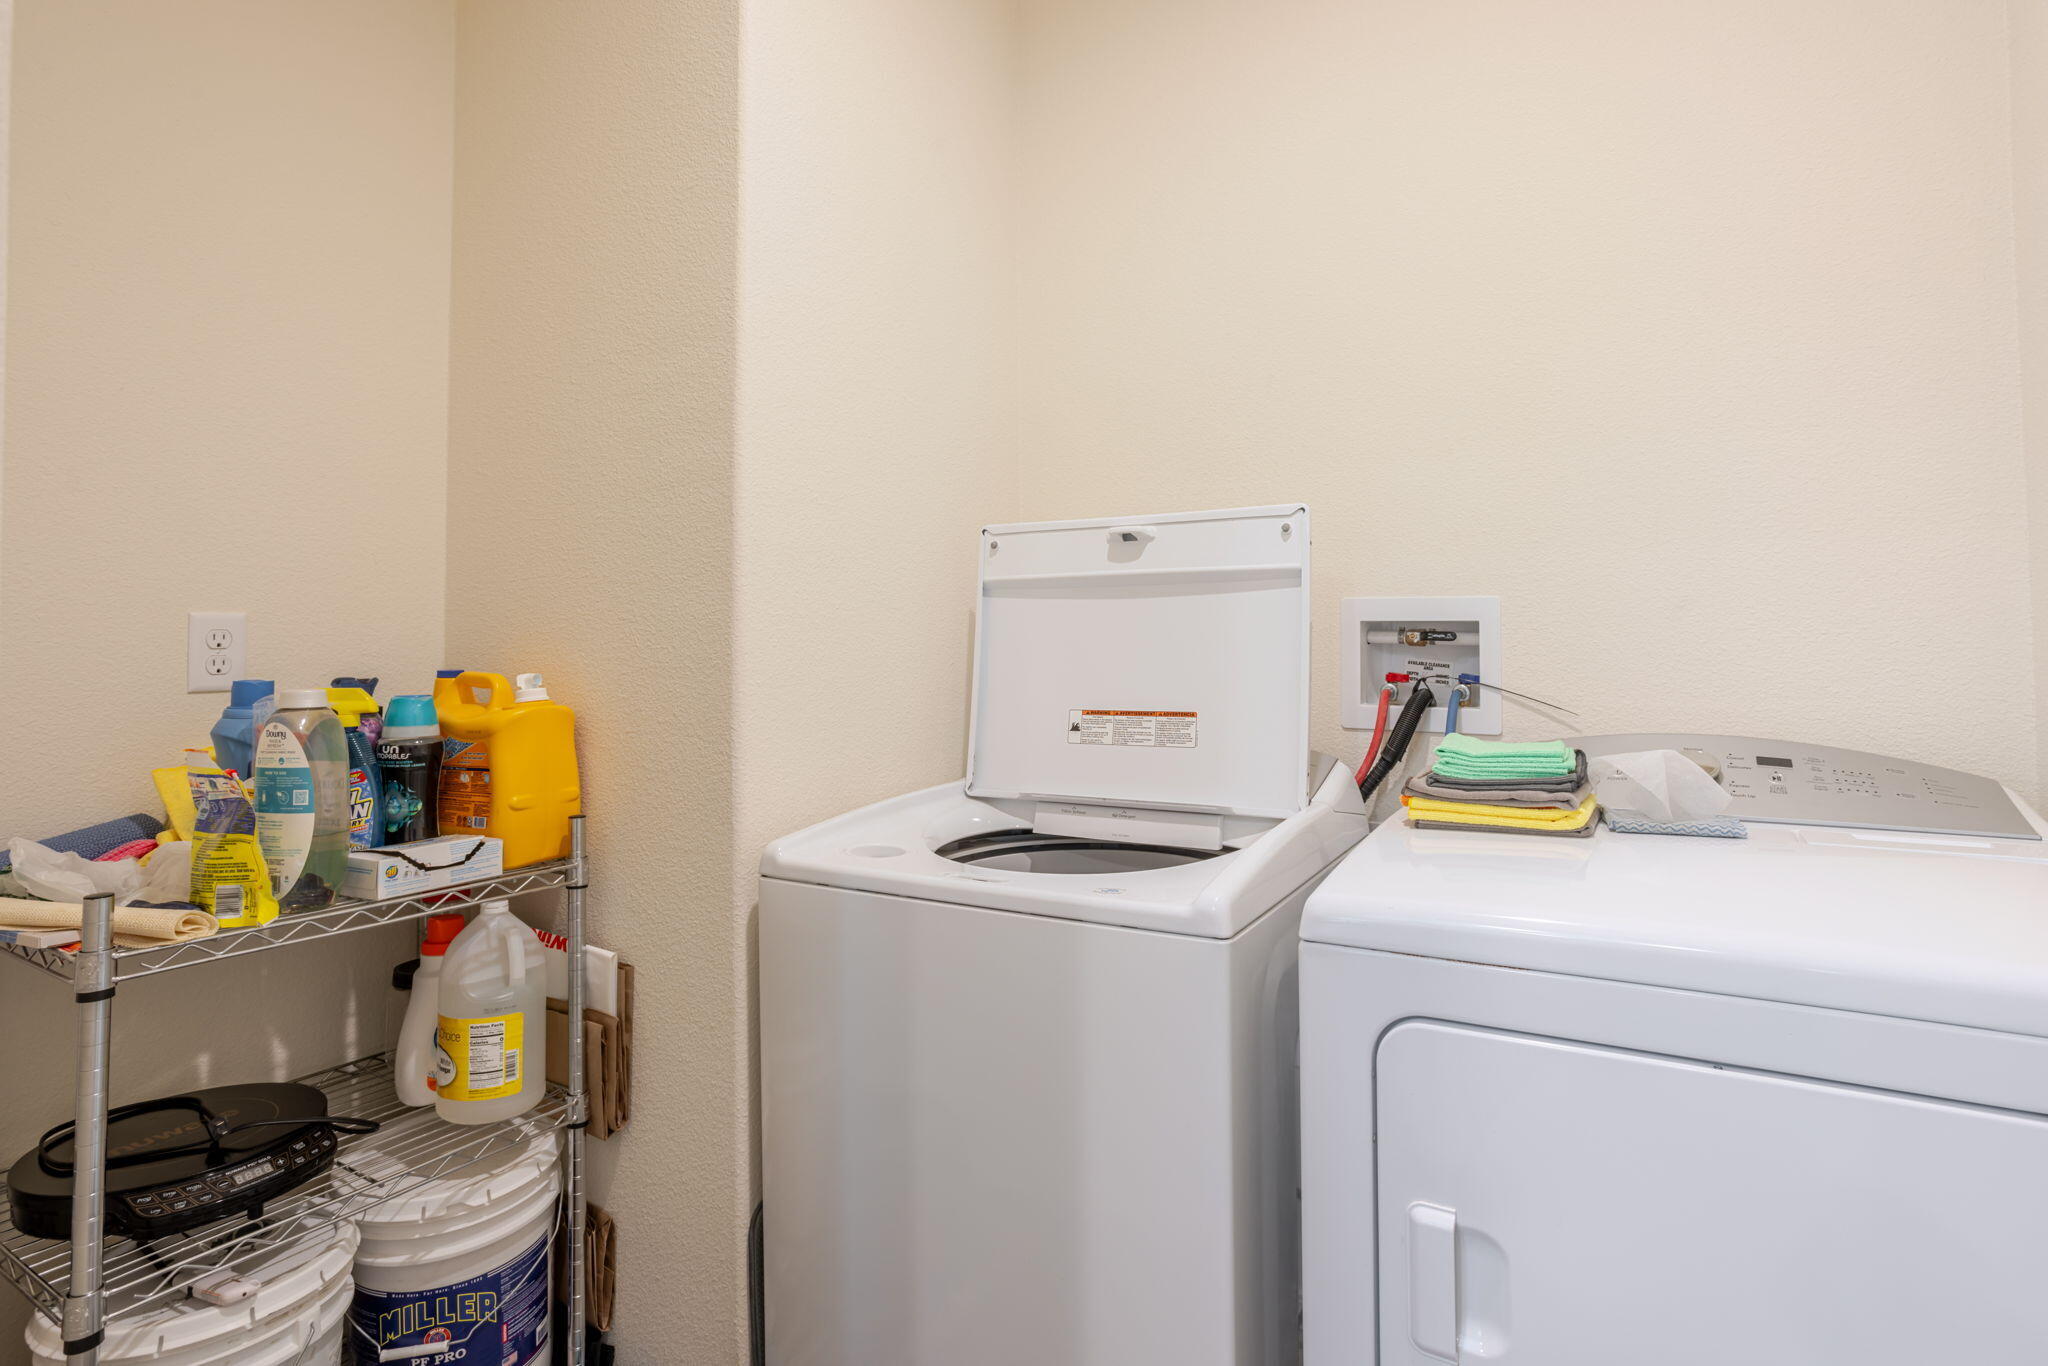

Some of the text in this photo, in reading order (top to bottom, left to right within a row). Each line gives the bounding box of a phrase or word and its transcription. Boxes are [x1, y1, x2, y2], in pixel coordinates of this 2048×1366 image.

[266, 730, 287, 740] Downy
[379, 1291, 497, 1346] MILLER
[411, 1348, 467, 1366] PF PRO
